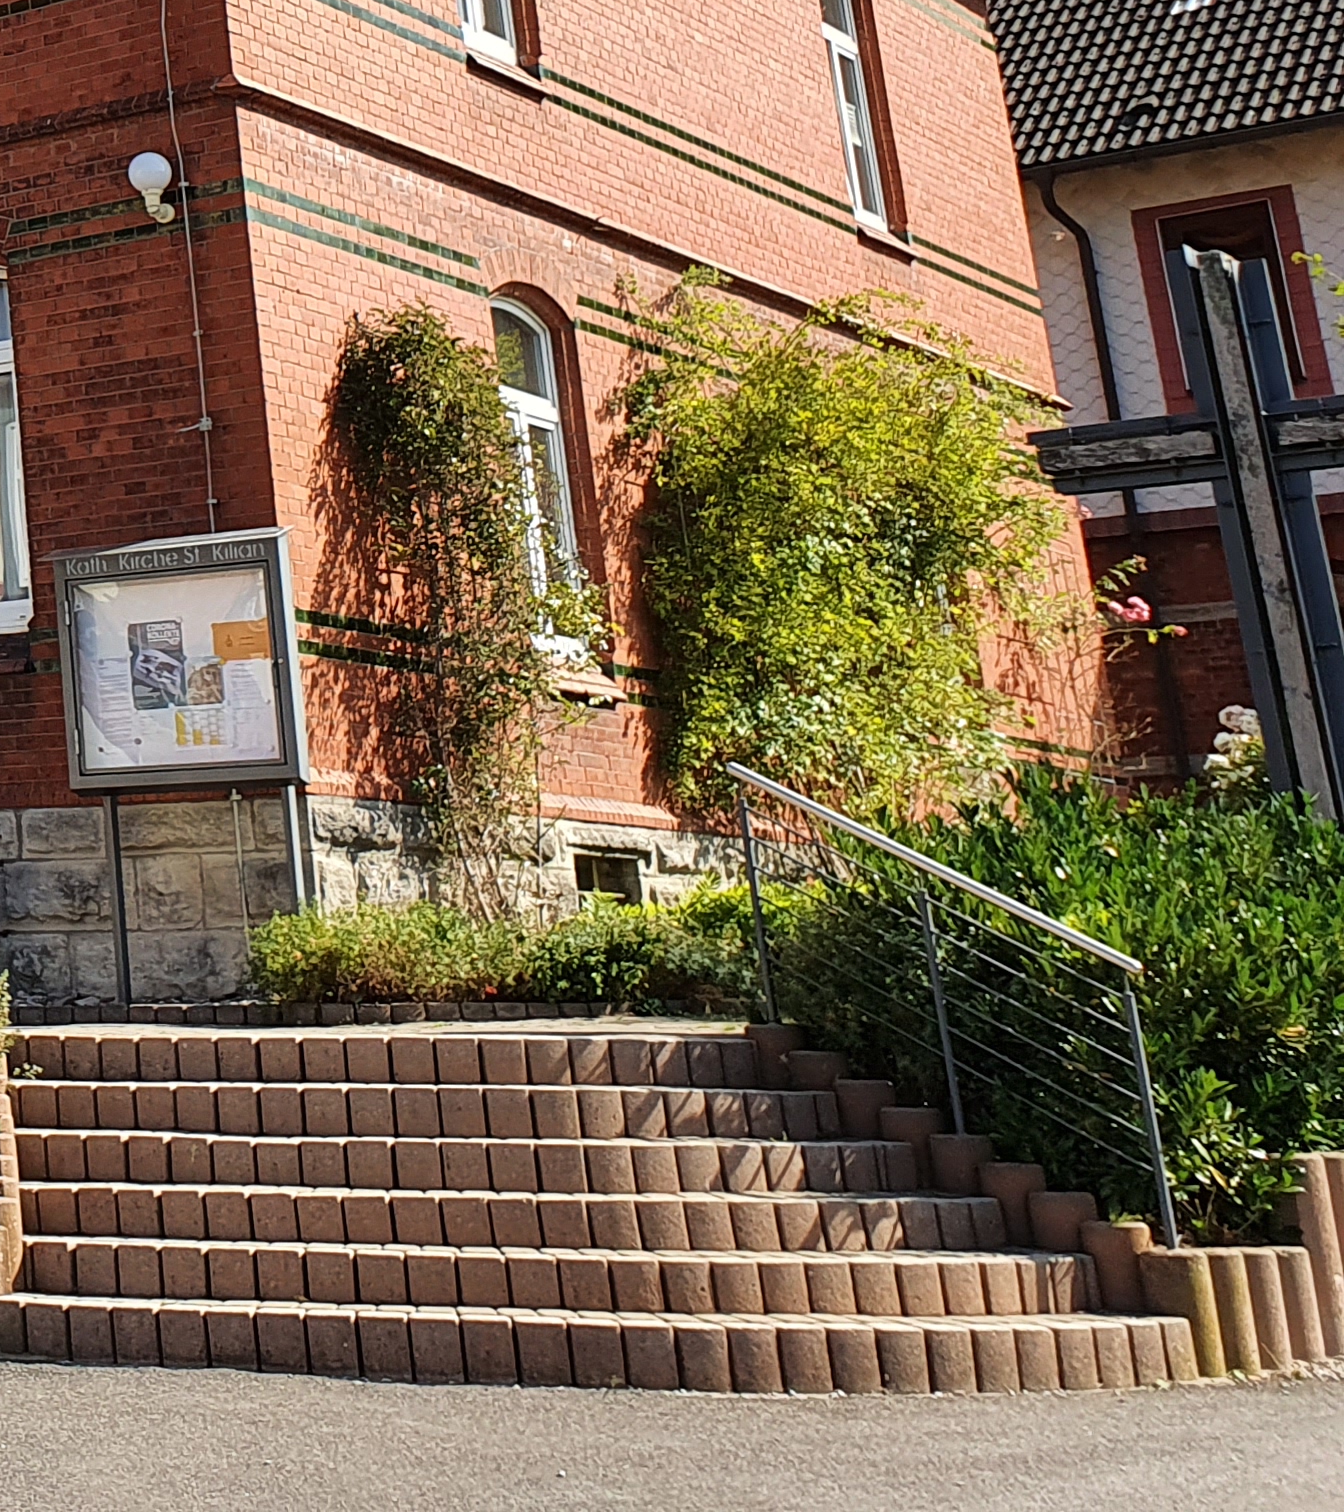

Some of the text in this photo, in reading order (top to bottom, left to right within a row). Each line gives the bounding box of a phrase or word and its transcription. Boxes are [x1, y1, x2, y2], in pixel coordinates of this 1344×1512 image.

[66, 542, 265, 576] Kath. Kirche St. Kilian
